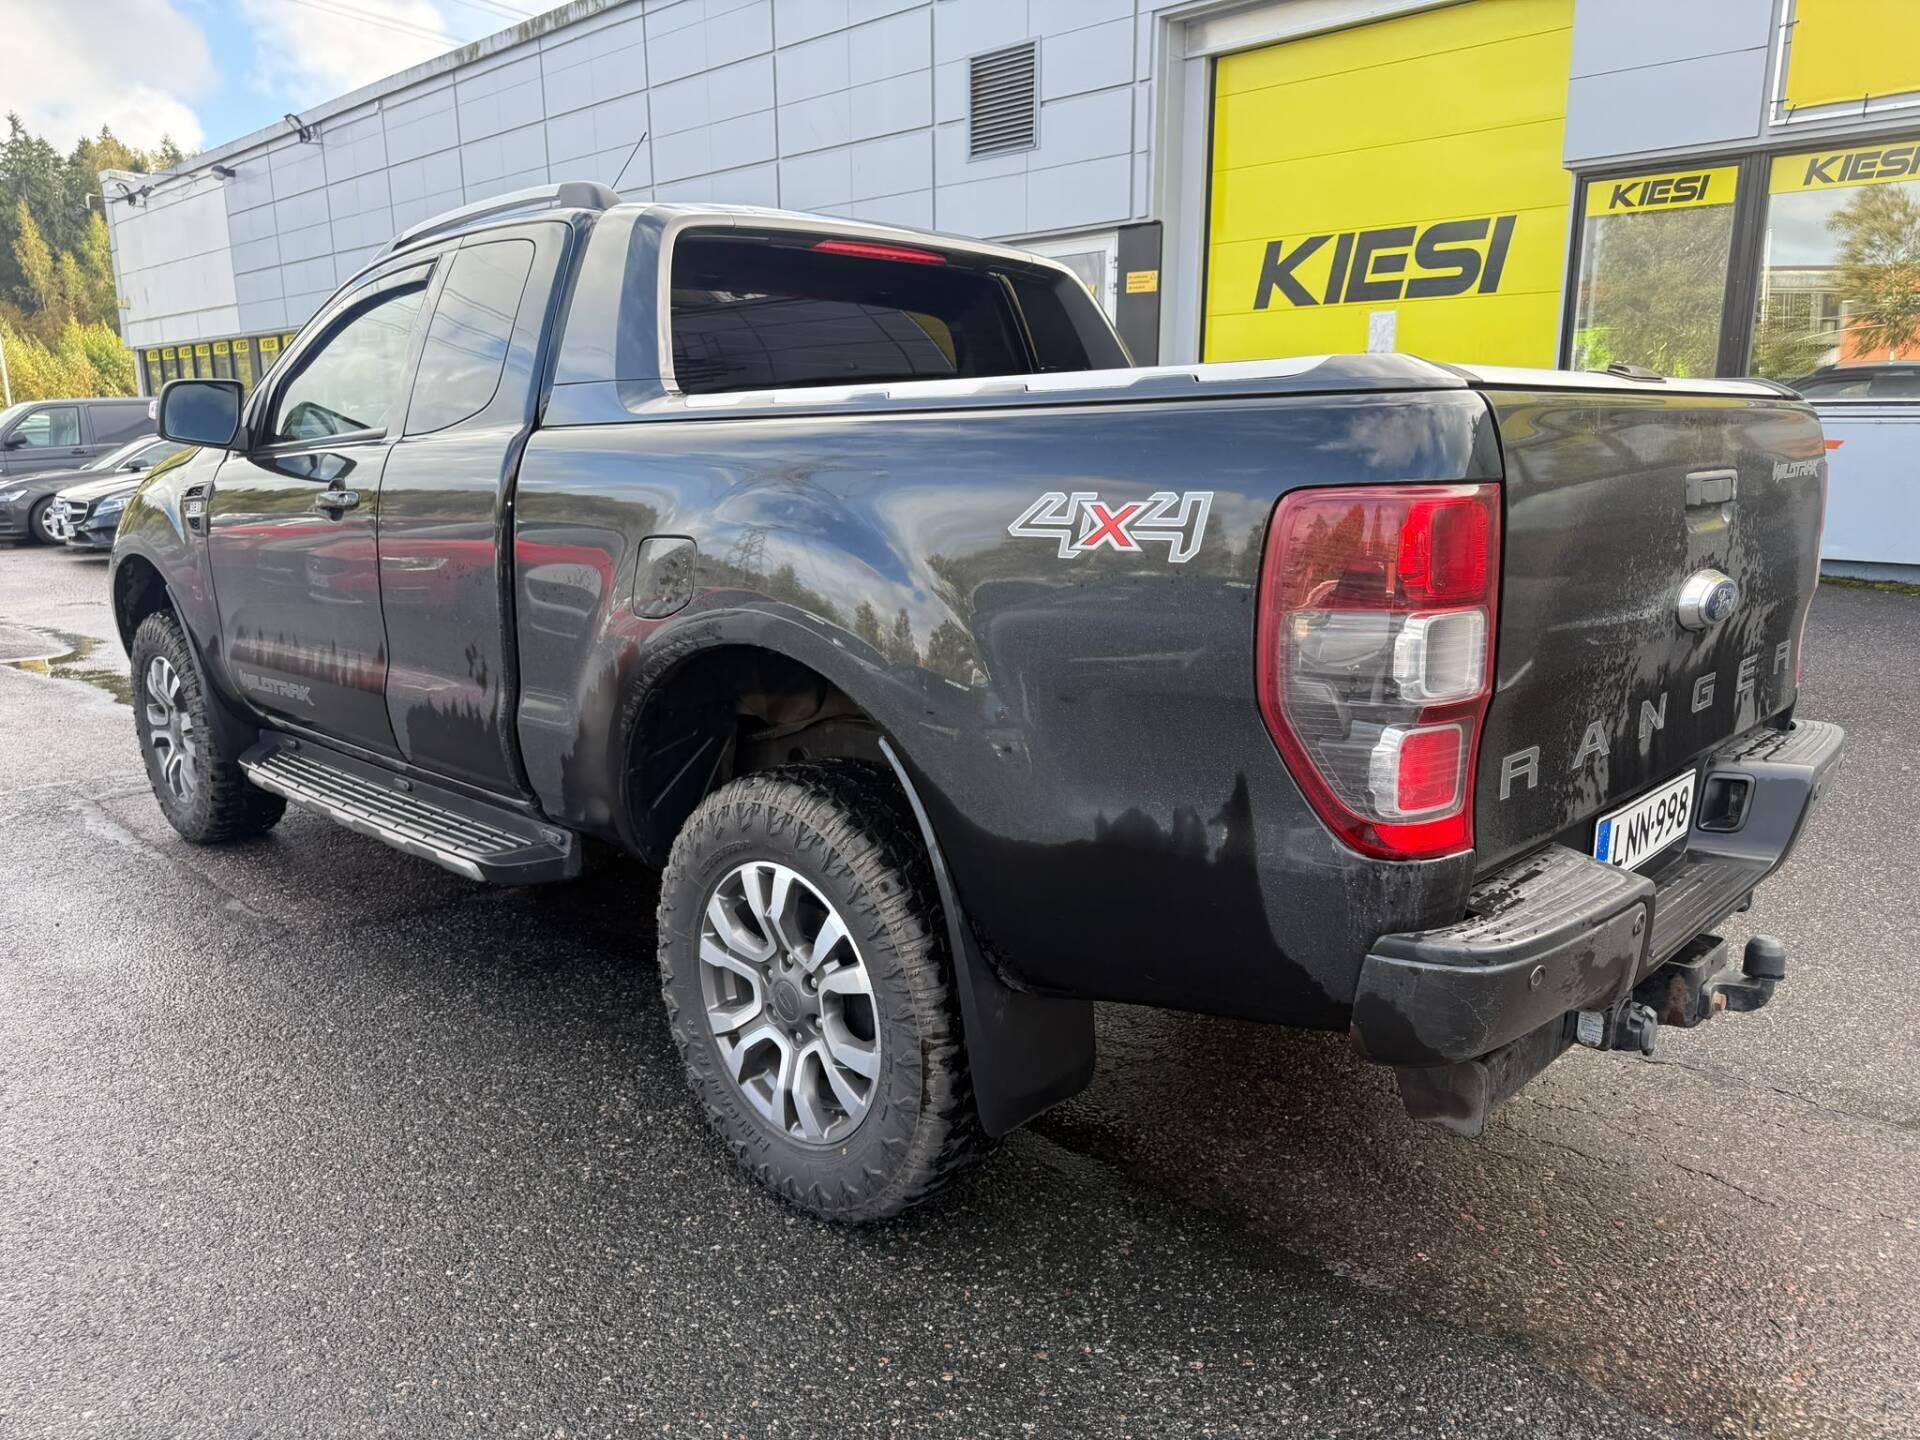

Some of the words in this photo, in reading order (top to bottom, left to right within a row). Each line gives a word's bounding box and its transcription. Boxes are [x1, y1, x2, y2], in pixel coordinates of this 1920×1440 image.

[1608, 174, 1711, 210] KIESI
[1803, 146, 1920, 186] KIESI
[1253, 214, 1518, 310] KIESI
[1499, 639, 1792, 801] RANGER
[1613, 786, 1689, 867] LNN-998
